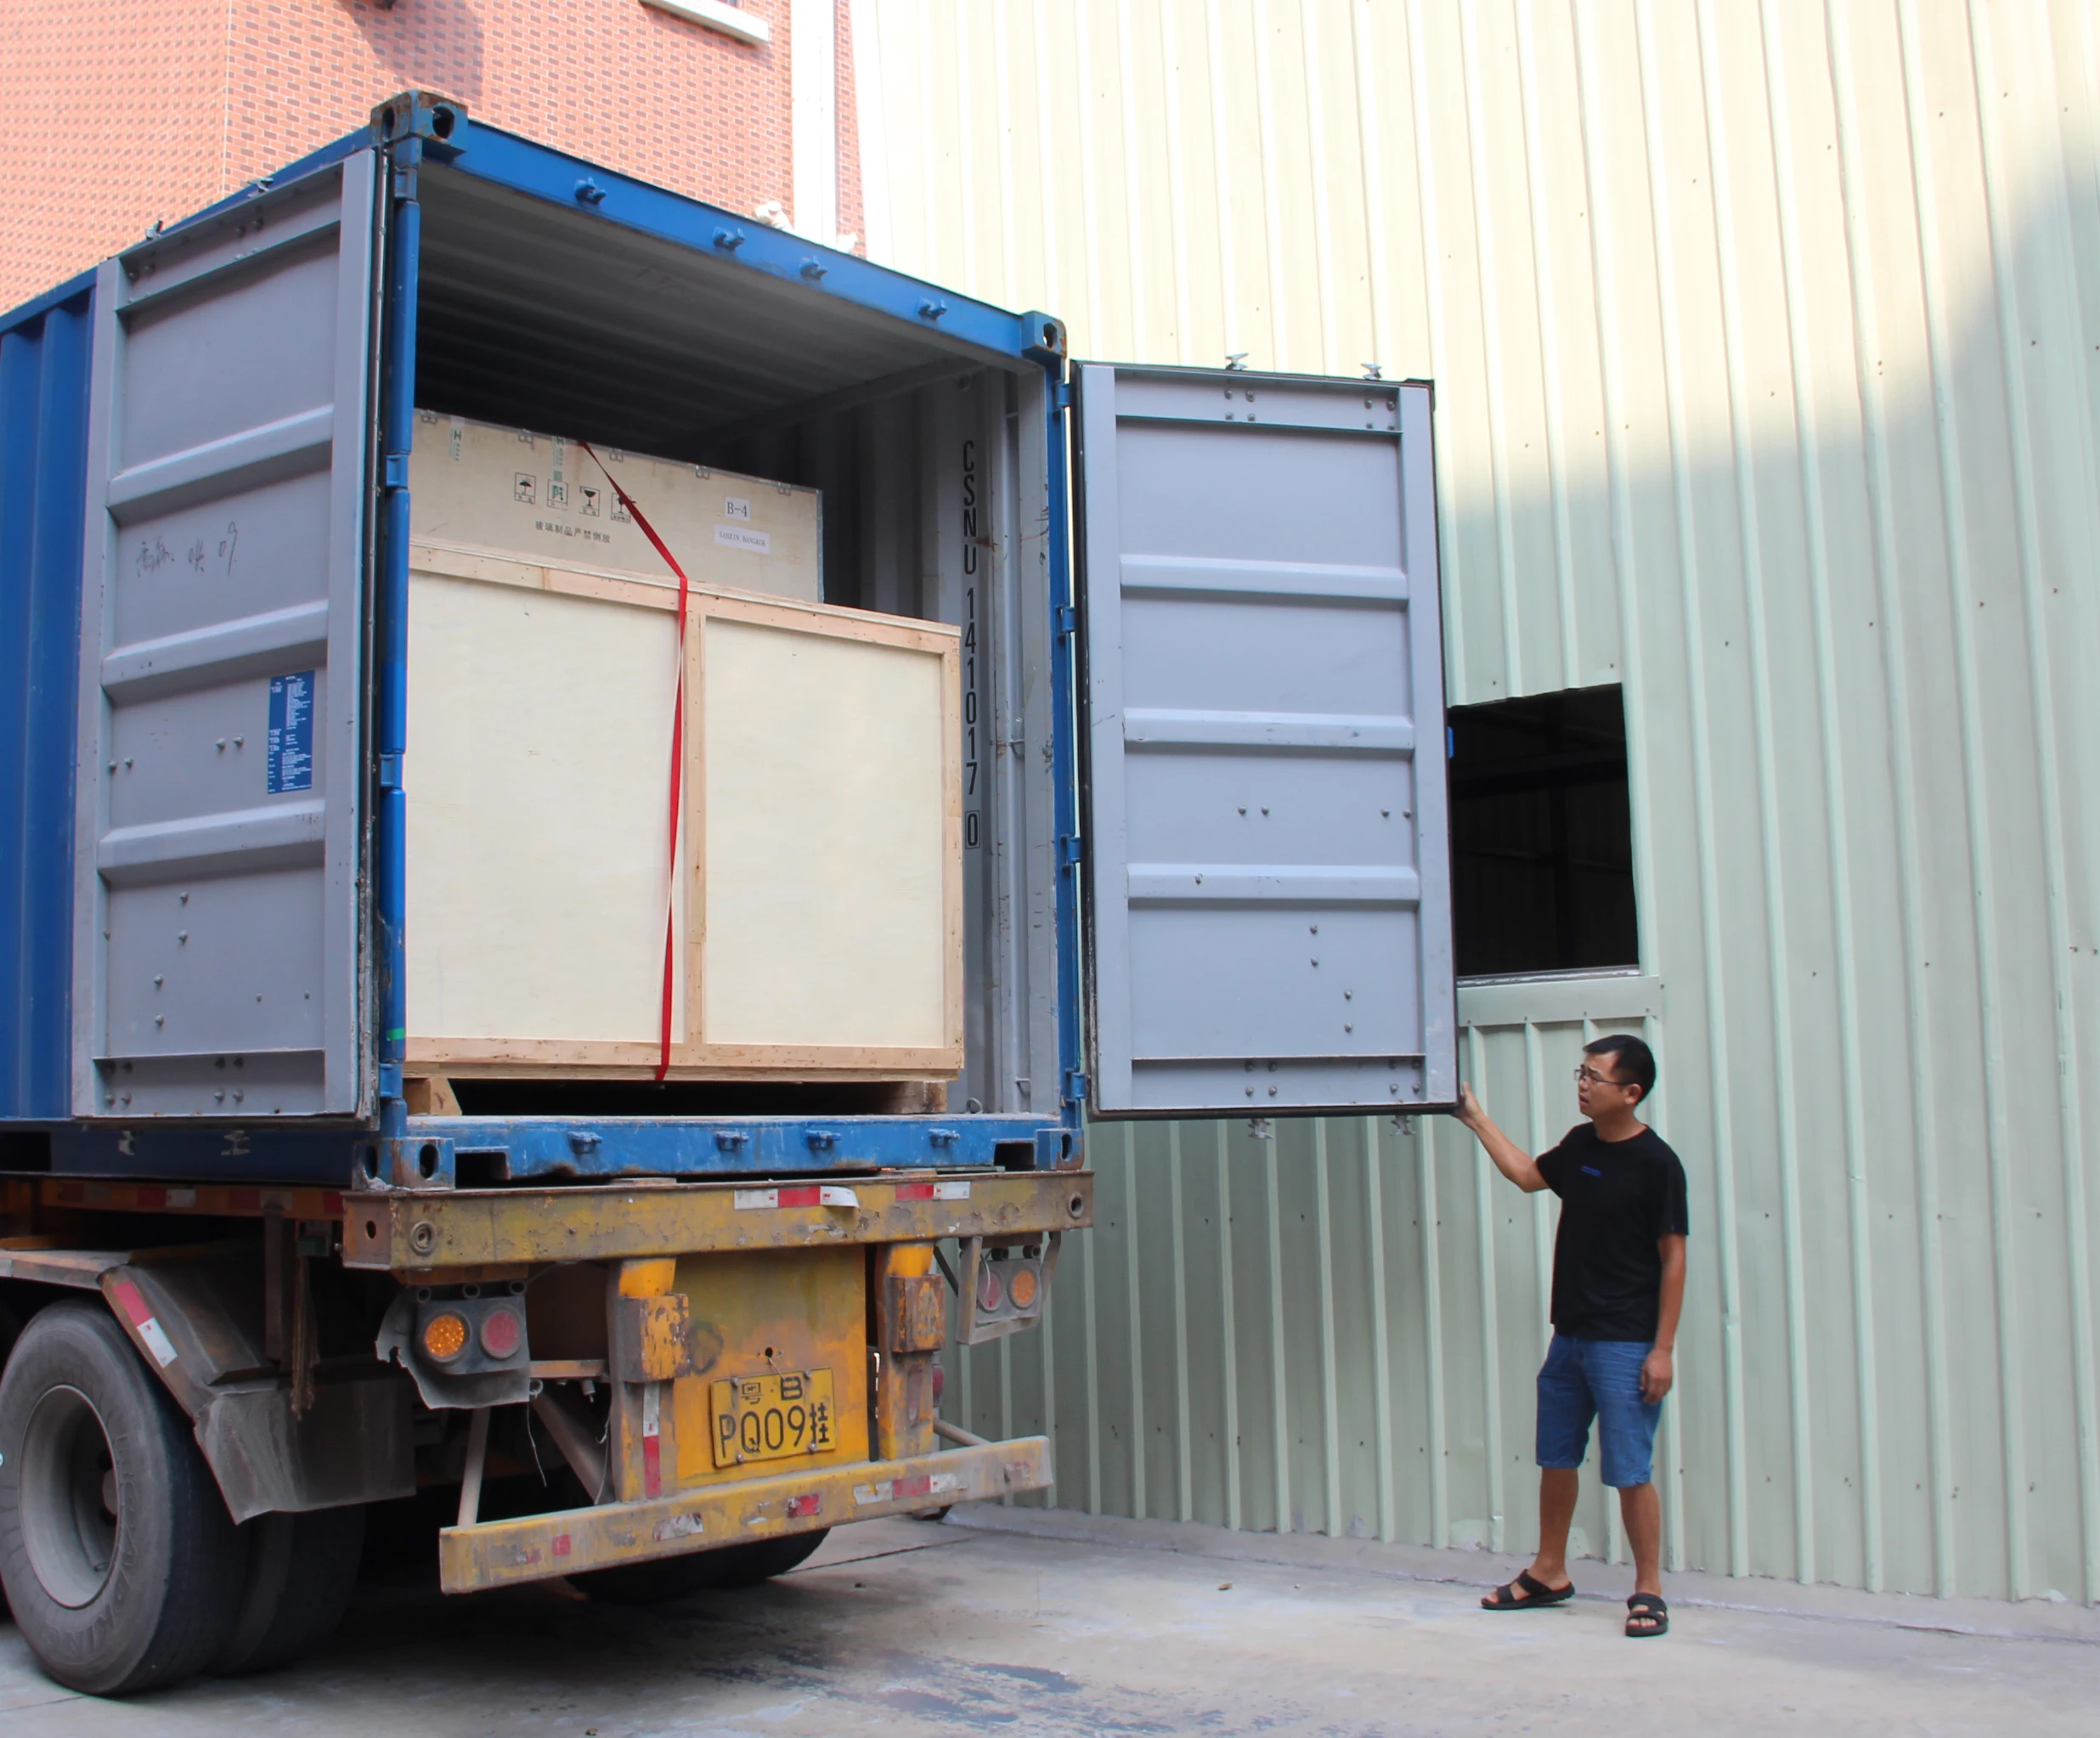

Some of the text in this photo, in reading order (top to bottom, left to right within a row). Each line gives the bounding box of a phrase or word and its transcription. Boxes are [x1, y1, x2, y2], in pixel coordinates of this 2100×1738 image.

[726, 501, 748, 517] B-4
[962, 440, 977, 575] CSNU
[965, 588, 978, 796] 141017
